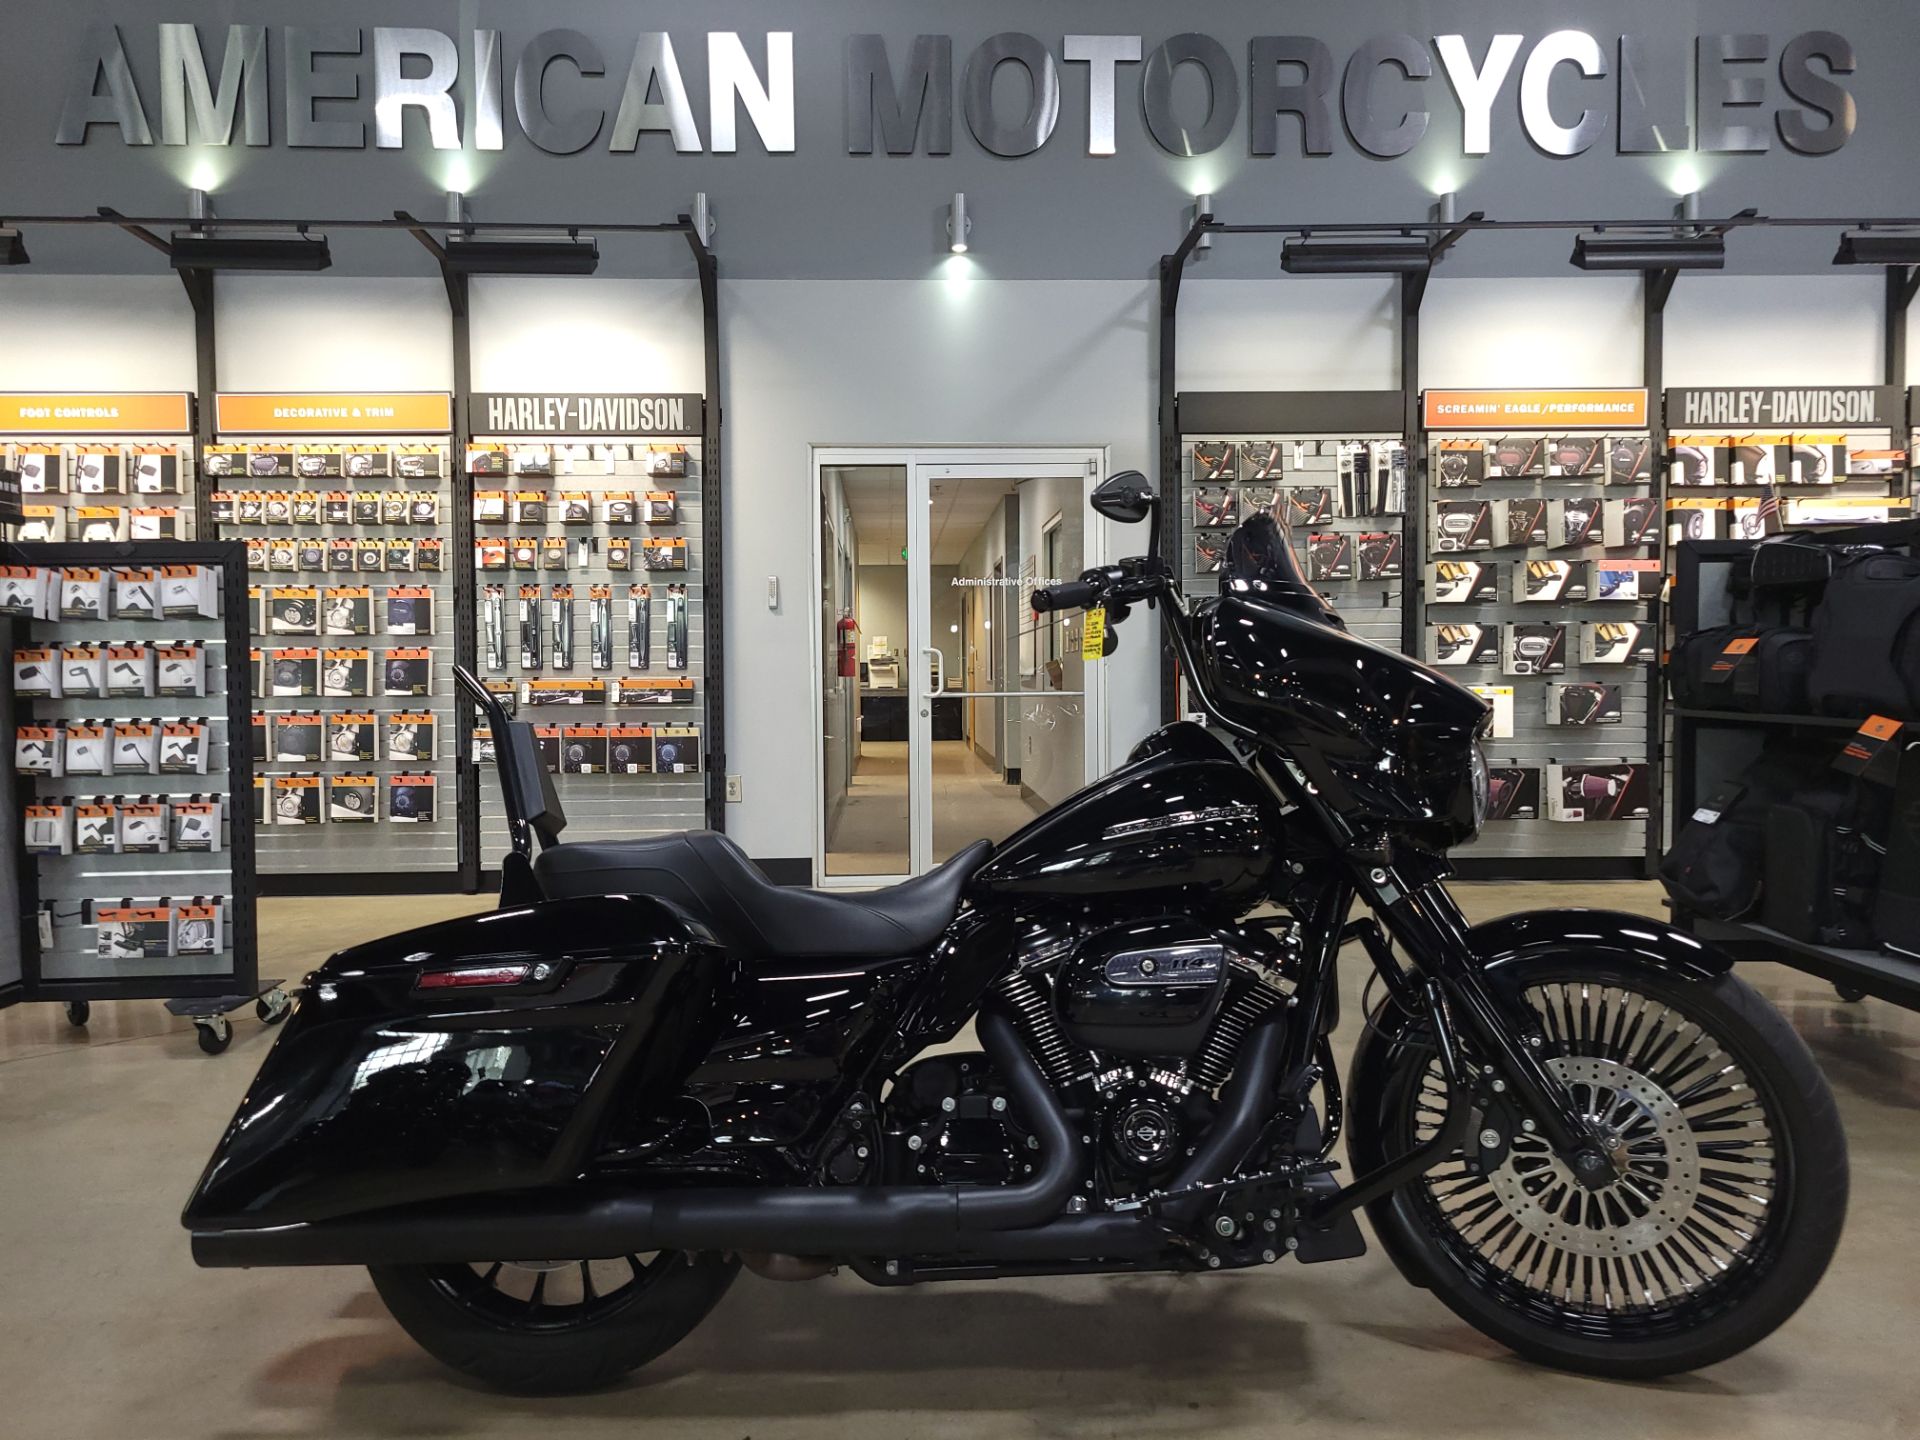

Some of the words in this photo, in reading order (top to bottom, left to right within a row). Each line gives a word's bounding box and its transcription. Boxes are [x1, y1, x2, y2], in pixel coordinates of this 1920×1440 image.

[55, 23, 796, 154] AMERICAN
[846, 29, 1858, 159] MOTORCYCLES
[19, 407, 50, 418] FOOT
[54, 407, 119, 418] CONTROLS
[273, 407, 348, 418] DECORATIVE
[352, 407, 361, 418] &
[365, 407, 395, 417] TRIM
[1436, 404, 1501, 414] SCREAMIN'
[1684, 390, 1876, 424] HARLEY-DAVIDSON
[488, 397, 684, 431] HARLEY-DAVIDSON
[951, 576, 1023, 587] Administrative
[1026, 576, 1063, 586] Offices
[1171, 956, 1207, 969] 114
